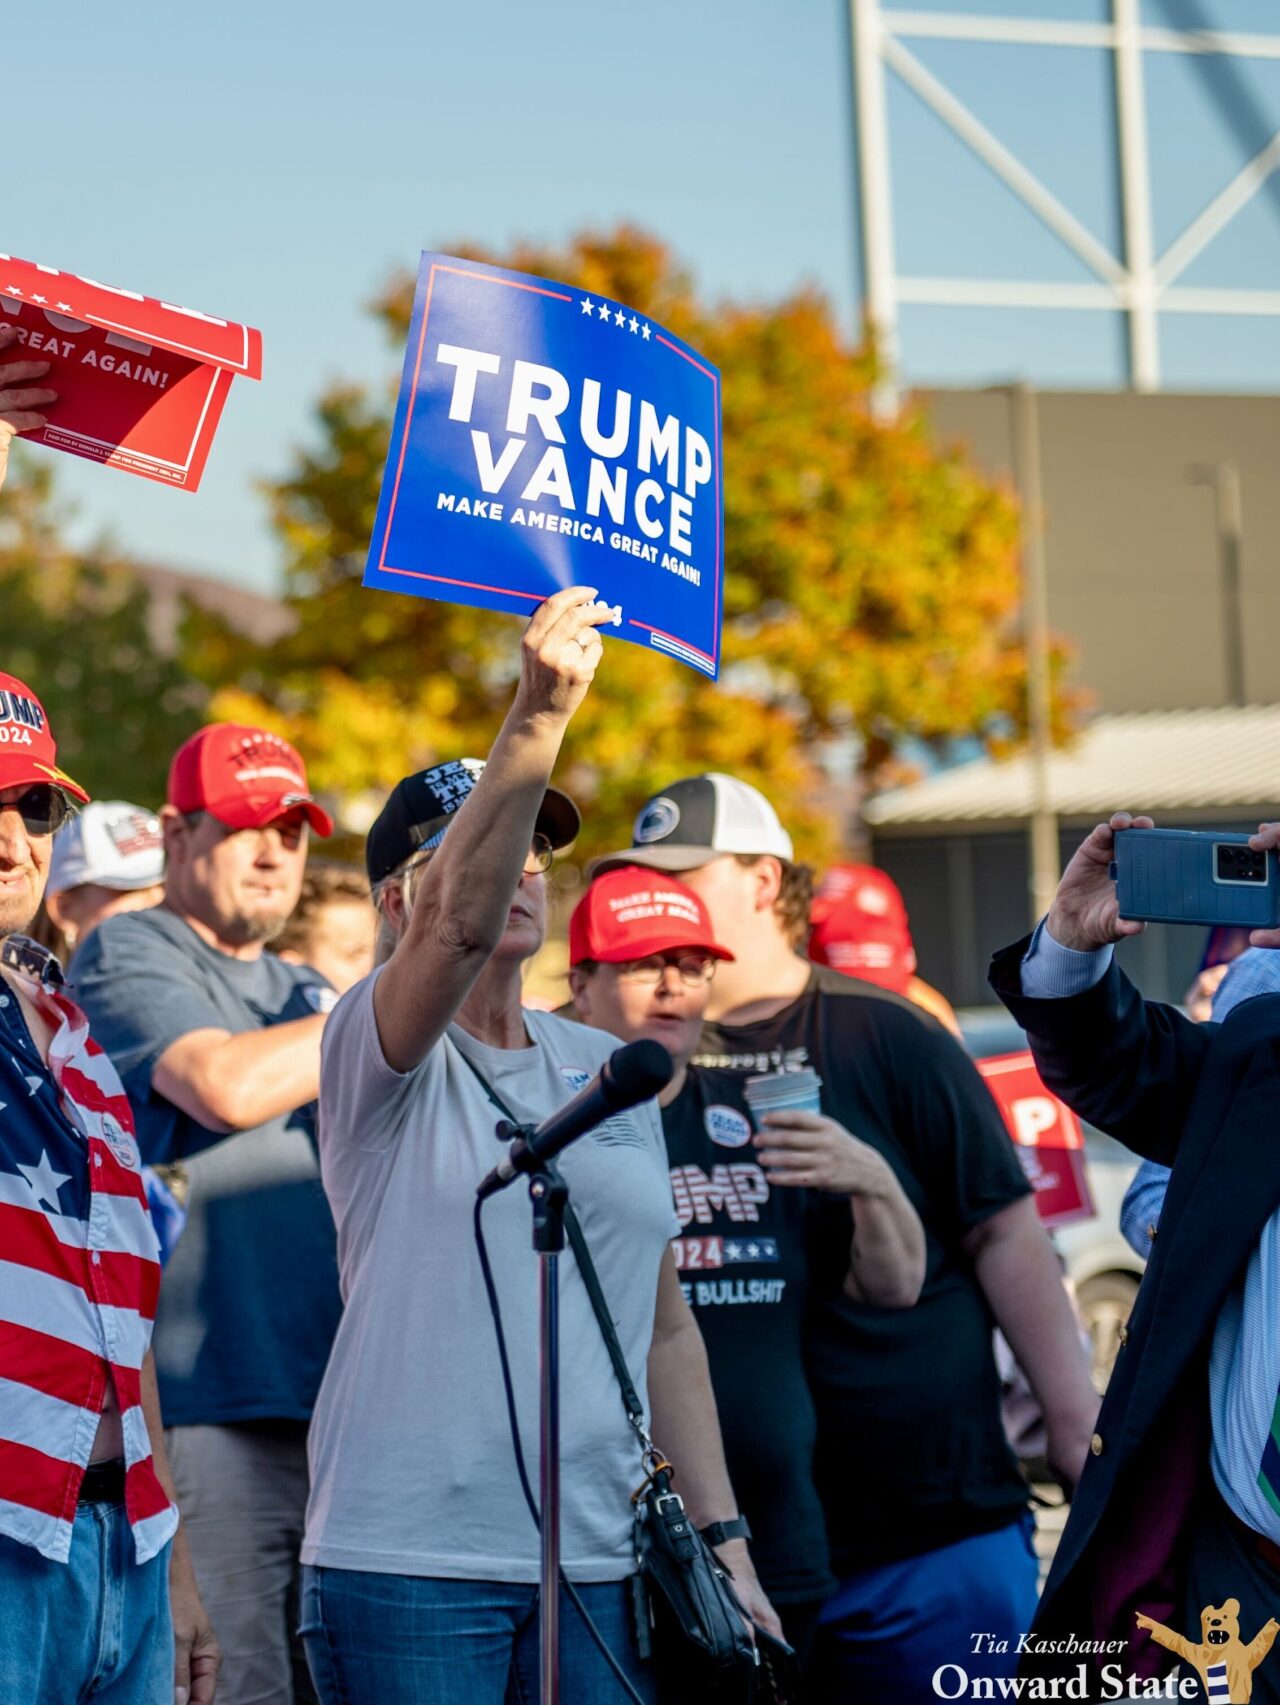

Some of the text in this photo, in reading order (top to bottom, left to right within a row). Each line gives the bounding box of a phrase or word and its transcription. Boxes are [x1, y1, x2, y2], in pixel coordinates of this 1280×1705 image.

[81, 349, 169, 389] AGAIN!
[436, 344, 713, 498] TRUMP
[471, 430, 693, 557] VANCE
[436, 493, 701, 587] MAKE AMERICA GREAT AGAIN!
[670, 1237, 723, 1269] 024
[695, 1278, 786, 1306] BULLSHIT
